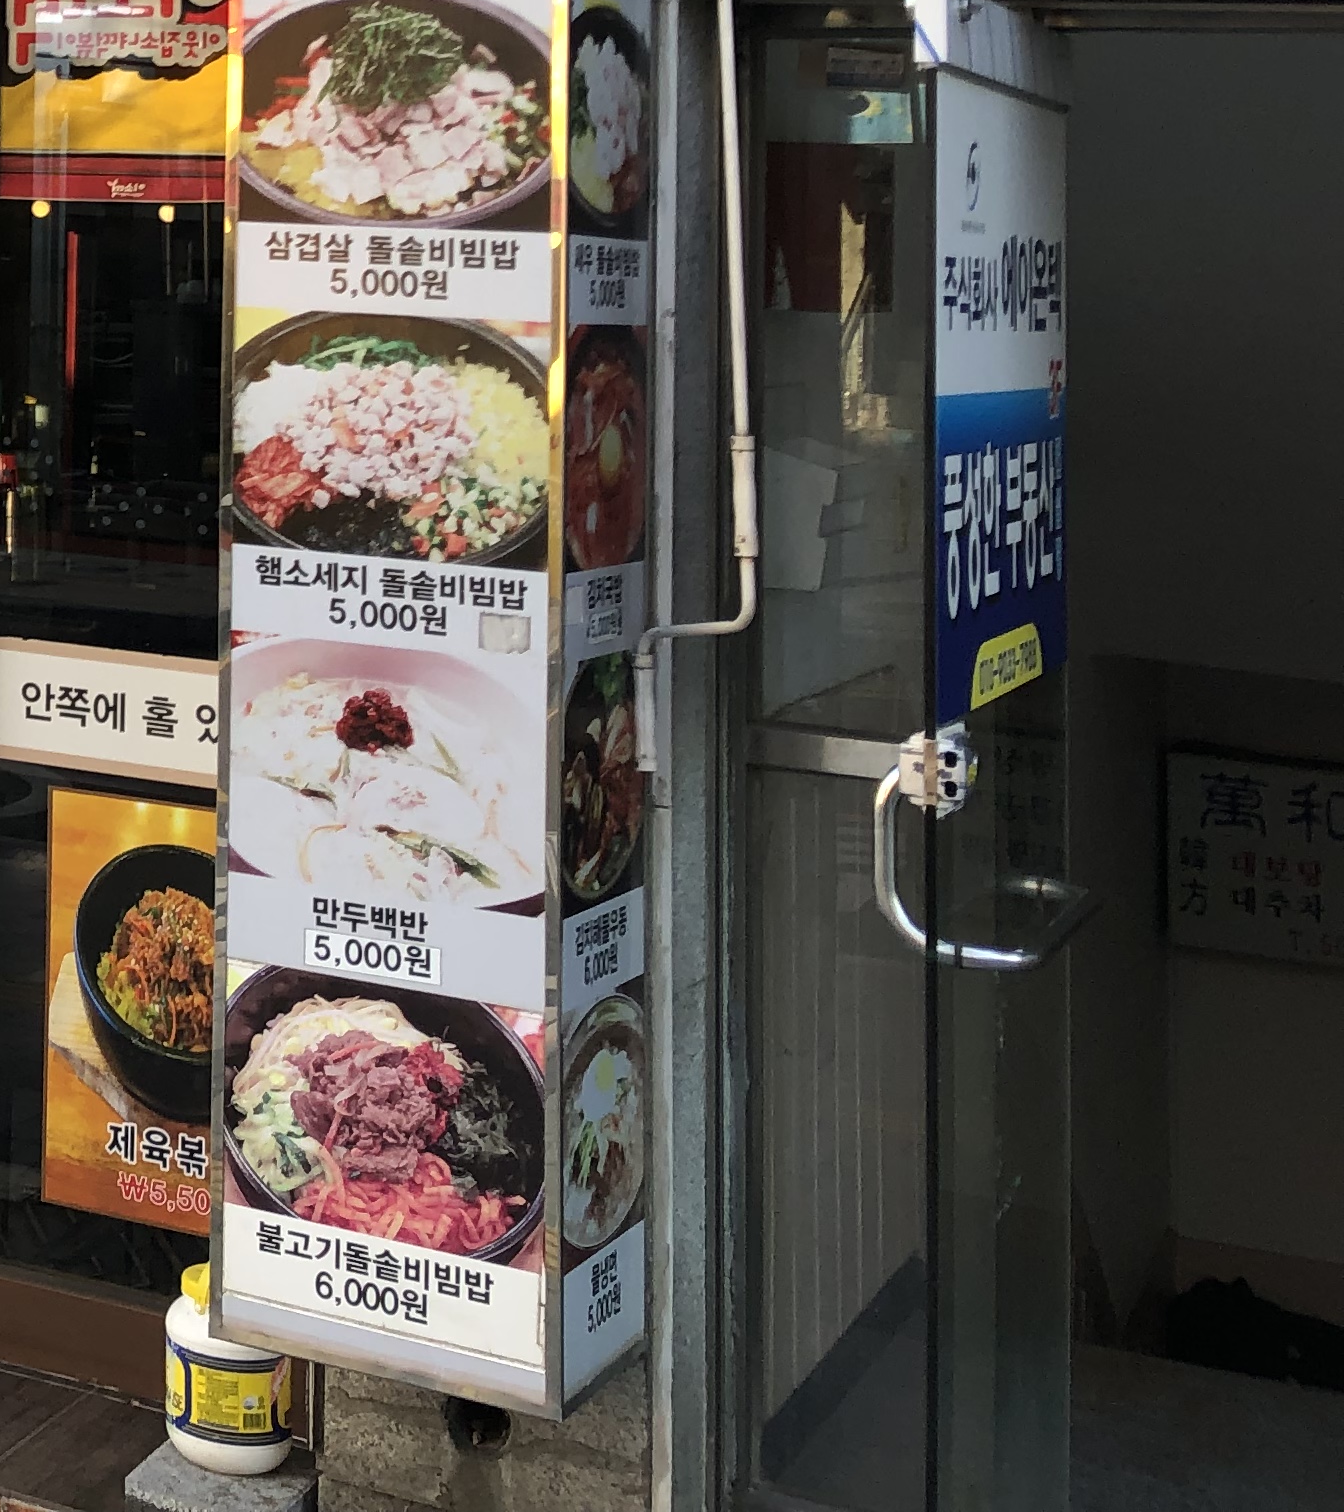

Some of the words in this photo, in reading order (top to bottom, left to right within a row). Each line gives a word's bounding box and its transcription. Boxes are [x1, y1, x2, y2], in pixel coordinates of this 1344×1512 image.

[265, 231, 353, 264] 삼겹살
[365, 233, 520, 270] 돌솥비빔밥
[330, 267, 449, 300] 5,000원
[943, 255, 998, 332] 주식회사
[943, 441, 1003, 620] 풍성한
[1006, 439, 1055, 591] 부동산
[255, 554, 368, 595] 햄소세지
[379, 568, 528, 612] 돌솥비빔밥
[328, 598, 448, 636] 5,000원
[21, 680, 128, 733] 안쪽에
[142, 696, 180, 739] 홀
[312, 897, 428, 943] 만두백반
[314, 934, 432, 979] 5,000원
[583, 941, 619, 987] 6,000원
[256, 1220, 495, 1305] 불고기돌솥비빔밥
[590, 1249, 618, 1292] 물냉면
[315, 1271, 429, 1325] 6,000원
[587, 1281, 623, 1333] 5,000원
